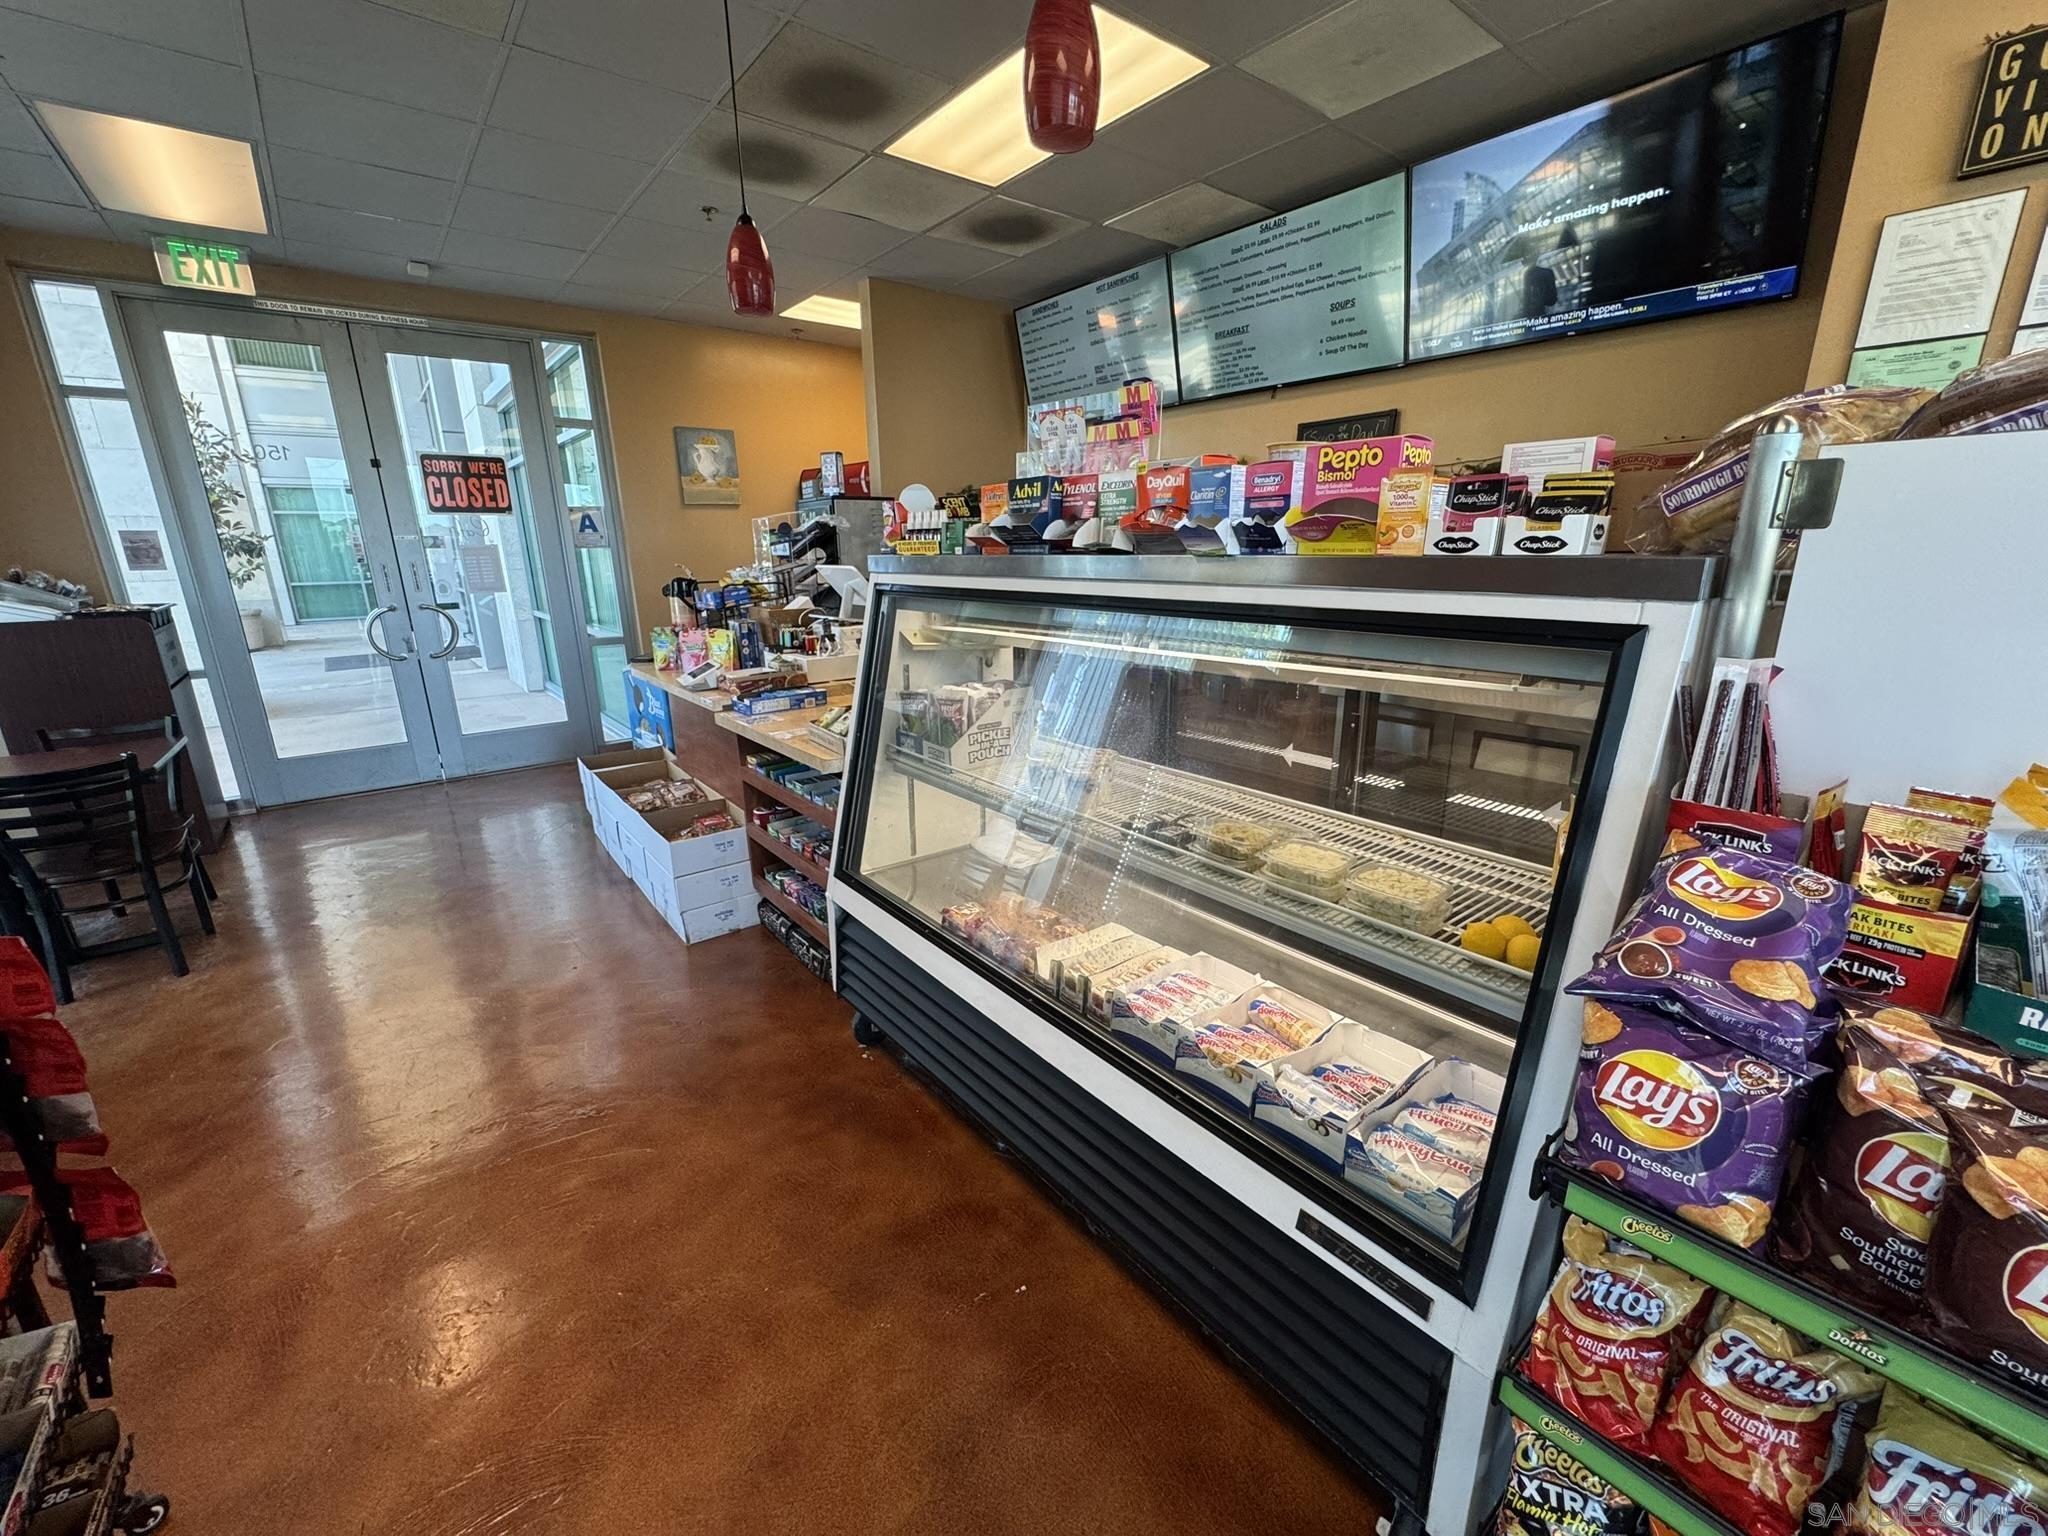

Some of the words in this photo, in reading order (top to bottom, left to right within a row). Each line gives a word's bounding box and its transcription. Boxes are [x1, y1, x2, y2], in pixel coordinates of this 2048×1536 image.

[1518, 216, 1550, 234] Make
[1553, 201, 1609, 223] amazing
[1611, 186, 1671, 209] happen.
[1259, 216, 1287, 234] SALADS
[167, 241, 240, 288] EXIT
[270, 302, 289, 310] DOOR
[1330, 297, 1356, 312] SOUPS
[1526, 316, 1549, 327] Make
[1550, 309, 1586, 322] amazing
[1587, 303, 1624, 317] happen.
[1214, 324, 1250, 340] BREAKFAST
[1318, 443, 1384, 471] Pepto
[1403, 441, 1432, 465] Pepto
[423, 459, 462, 474] SORRY
[468, 461, 504, 475] WE'RE
[1317, 468, 1356, 482] Bismol
[1062, 482, 1096, 495] TYLENOL
[1146, 472, 1185, 489] DayQuil
[1253, 475, 1282, 485] Benadryl
[1253, 485, 1280, 493] ALLERGY
[426, 476, 510, 508] CLOSED
[1013, 481, 1041, 499] Advil
[1100, 492, 1117, 500] EXTRA
[1190, 490, 1214, 501] Claritin
[1453, 492, 1499, 505] ChapStick
[1665, 470, 1733, 510] SOURDOUGH
[942, 497, 966, 508] SCENT
[1100, 498, 1127, 506] STRENGTH
[1535, 506, 1587, 516] ChapStick
[578, 513, 599, 533] A
[1438, 539, 1474, 550] ChapStick
[1520, 539, 1561, 550] ChapStick
[968, 727, 1011, 746] PICKLE
[968, 744, 1011, 764] POUCH
[1674, 862, 1777, 907] Lay's
[1897, 893, 1931, 906] BITES
[1655, 903, 1678, 920] All
[1683, 909, 1757, 948] Dressed
[1852, 922, 1895, 939] RIYAKI
[1873, 917, 1914, 934] BITES
[1883, 942, 1907, 954] PROTEIN
[1705, 1007, 1721, 1020] NET
[1599, 1062, 1714, 1129] Lay's
[1374, 1134, 1429, 1161] Honey
[1590, 1131, 1613, 1152] All
[1617, 1144, 1696, 1188] Dressed
[1621, 1216, 1673, 1243] Cheetos
[1858, 1251, 1924, 1289] Barbe
[1562, 1324, 1574, 1340] The
[1576, 1335, 1640, 1361] ORIGINAL
[1827, 1328, 1888, 1366] Doritos
[1711, 1327, 1837, 1405] Fritos
[1700, 1391, 1719, 1411] The
[1721, 1407, 1800, 1449] ORIGINAL
[1540, 1416, 1583, 1445] Cheetos
[1515, 1436, 1604, 1495] Cheetos
[1506, 1487, 1561, 1523] Flamin'
[1562, 1512, 1604, 1536] Hot
